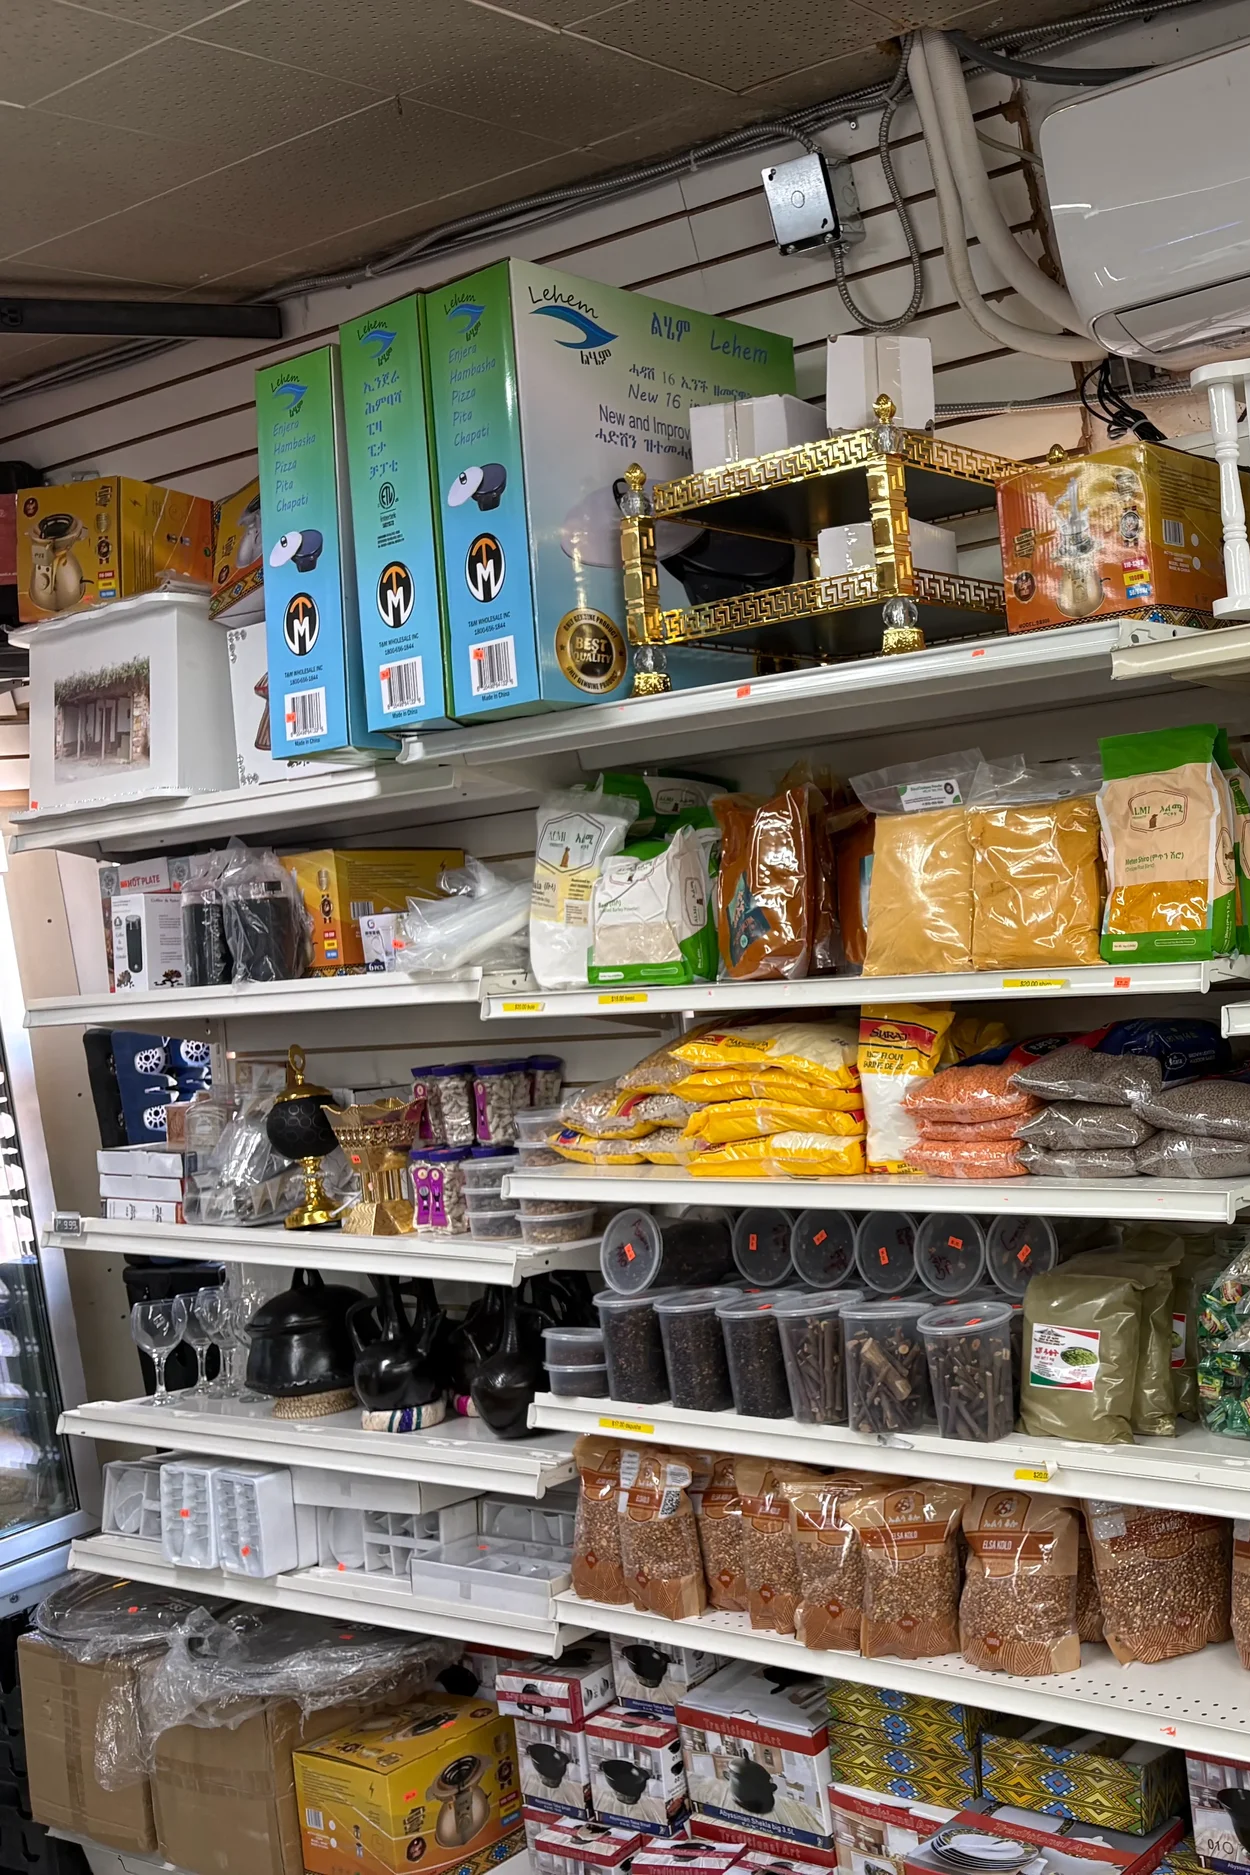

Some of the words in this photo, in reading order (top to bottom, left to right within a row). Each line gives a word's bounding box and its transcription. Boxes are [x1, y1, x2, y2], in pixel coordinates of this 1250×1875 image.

[443, 292, 476, 315] Lehem
[528, 285, 599, 320] Lehem
[357, 320, 388, 341] Lehem
[448, 344, 477, 364] Enjera
[709, 329, 769, 366] Lehem
[450, 356, 496, 384] Hambasha
[270, 374, 300, 393] Lehem
[452, 387, 476, 406] Pizza
[273, 420, 299, 437] Enjera
[453, 411, 473, 427] Pita
[599, 404, 630, 426] New
[629, 411, 650, 432] and
[653, 416, 691, 441] Improv
[274, 433, 316, 455] Hambasha
[454, 423, 490, 447] Chapati
[274, 460, 297, 475] Pizza
[275, 480, 293, 494] Pita
[276, 493, 309, 512] Chapati
[575, 636, 608, 651] BEST
[573, 651, 613, 664] QUALITY
[141, 874, 160, 886] PLATE
[869, 1028, 909, 1042] SURAJ
[904, 1530, 918, 1539] KOLO
[982, 1540, 995, 1551] ELSA
[996, 1540, 1012, 1551] KOLO
[703, 1719, 762, 1741] Traditional
[764, 1734, 782, 1746] Art
[719, 1809, 749, 1824] Abyssinian
[750, 1816, 772, 1829] Shekla
[772, 1821, 782, 1833] big
[782, 1825, 795, 1836] 3.5L
[853, 1799, 914, 1826] Traditional
[916, 1818, 937, 1833] Art
[718, 1828, 781, 1853] Traditional
[782, 1844, 800, 1857] Art
[993, 1822, 1071, 1849] Traditional
[1074, 1842, 1098, 1857] Art
